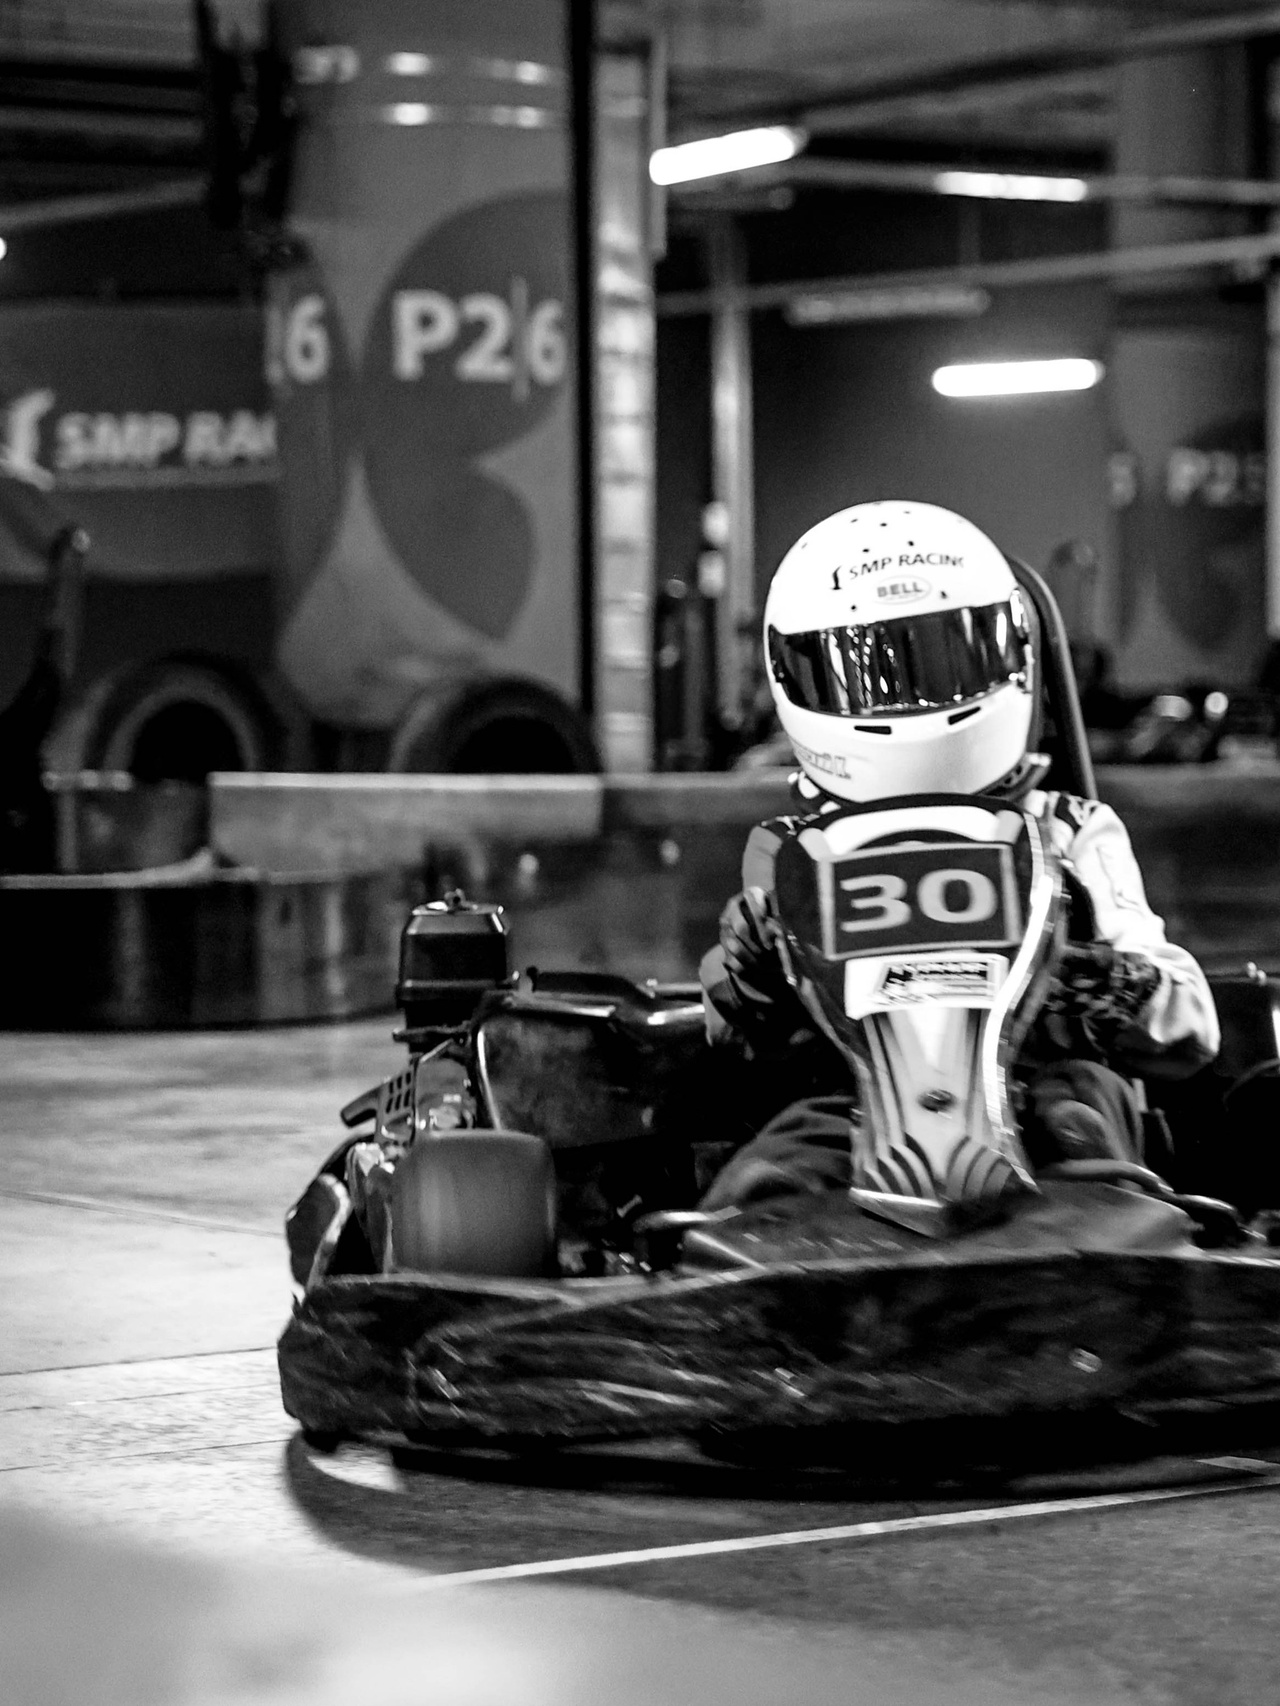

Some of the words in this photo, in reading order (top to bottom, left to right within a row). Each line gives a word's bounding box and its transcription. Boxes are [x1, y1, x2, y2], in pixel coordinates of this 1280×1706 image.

[56, 411, 180, 469] SMP
[849, 557, 892, 580] SMP
[877, 581, 923, 598] BELL
[840, 868, 998, 932] 30
